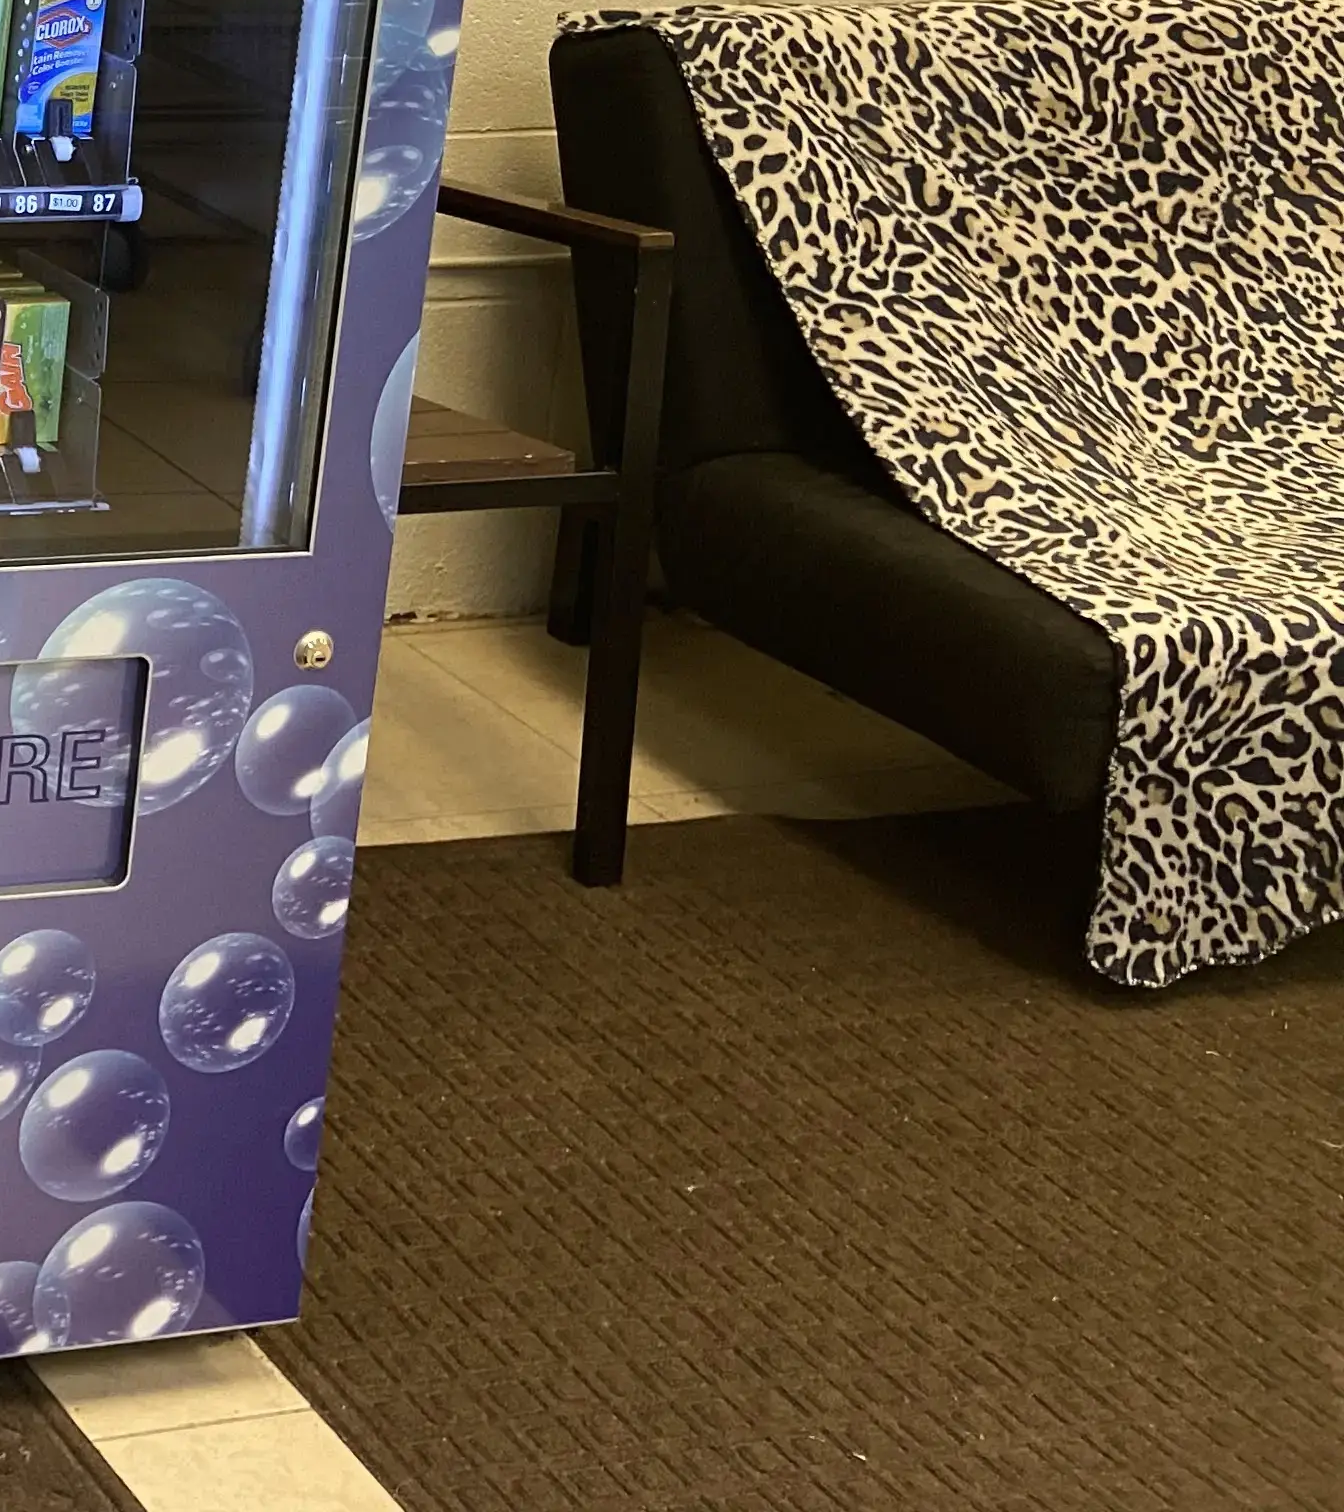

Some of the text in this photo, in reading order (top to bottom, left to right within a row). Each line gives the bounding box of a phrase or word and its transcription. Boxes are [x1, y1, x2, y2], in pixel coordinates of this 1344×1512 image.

[36, 15, 86, 41] CLOROX
[15, 195, 38, 214] 86
[92, 193, 115, 211] 87
